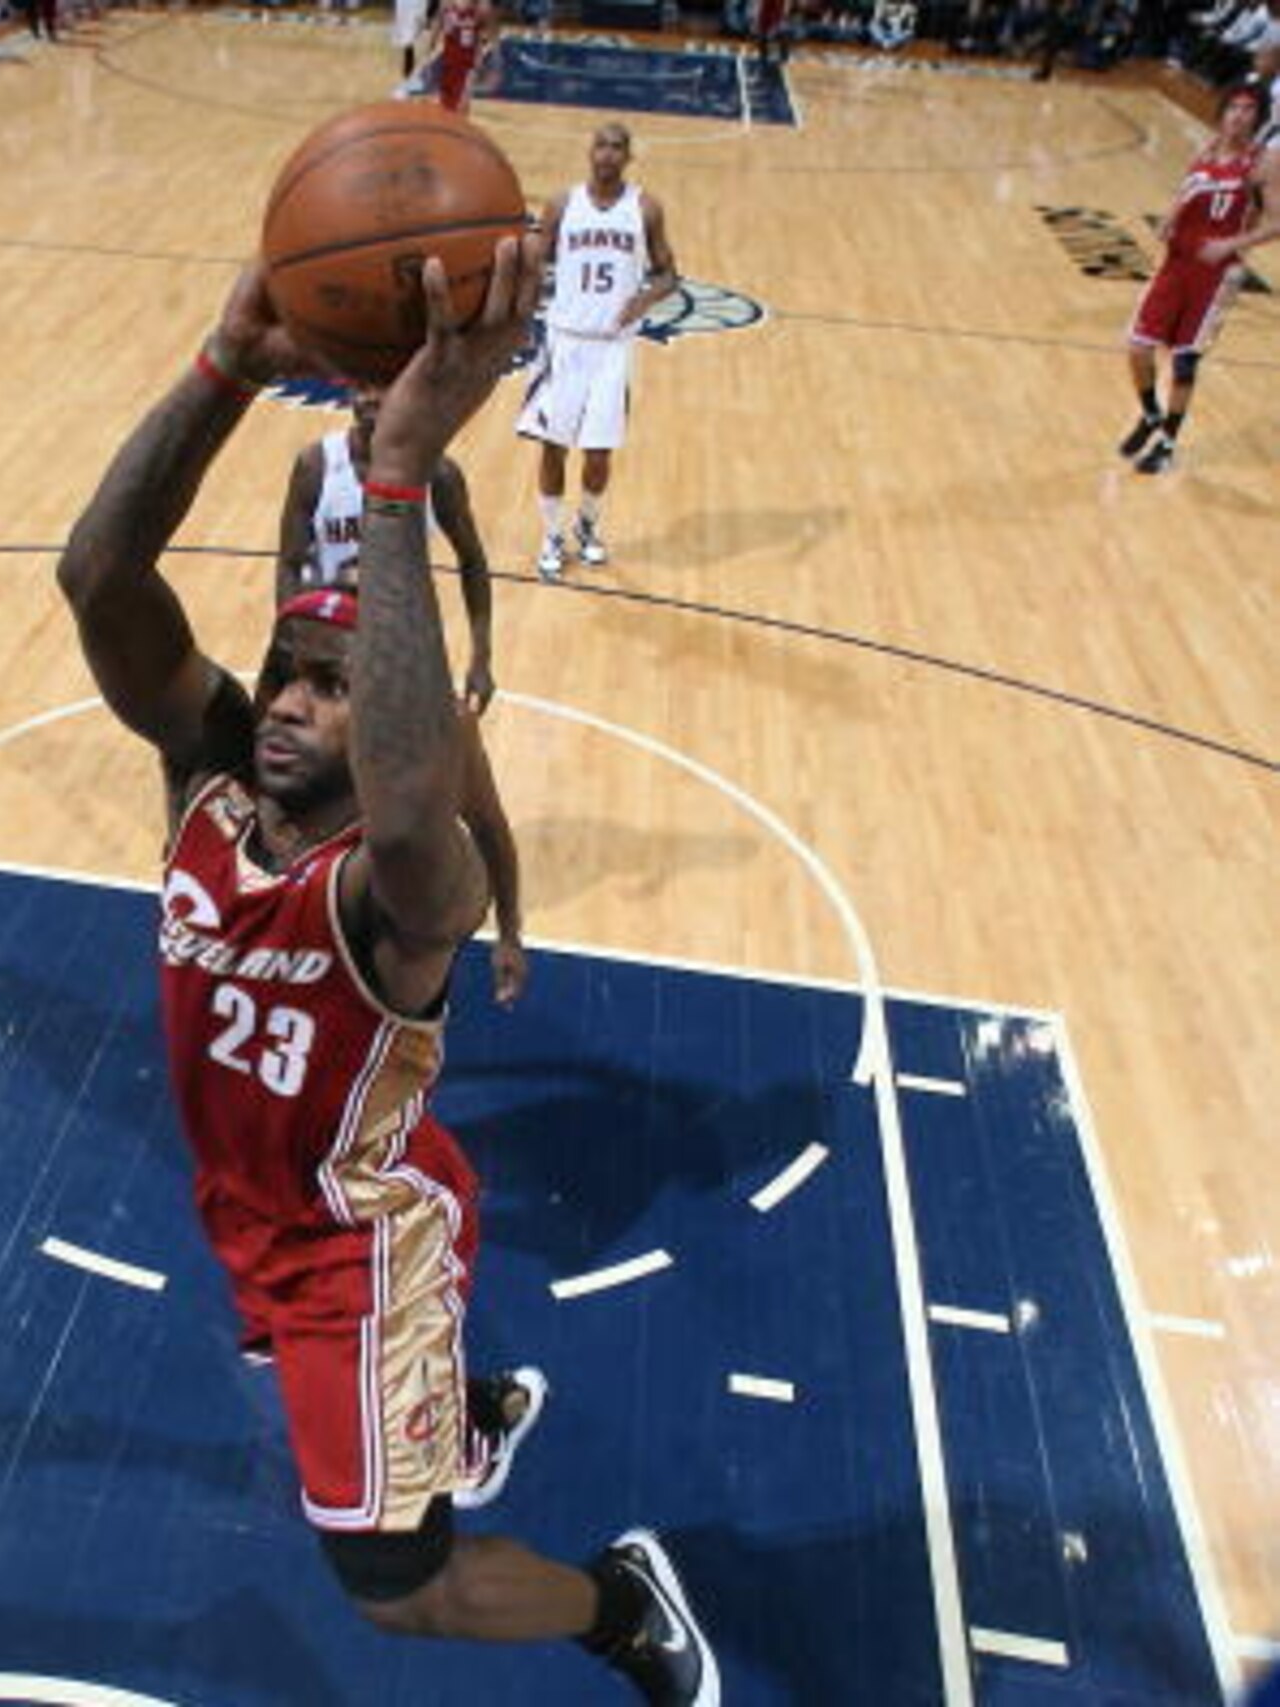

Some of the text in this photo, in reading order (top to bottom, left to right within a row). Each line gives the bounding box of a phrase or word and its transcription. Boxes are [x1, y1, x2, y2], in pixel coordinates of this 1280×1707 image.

[581, 262, 614, 293] 15
[160, 868, 333, 984] CEVELAND
[209, 983, 316, 1098] 23
